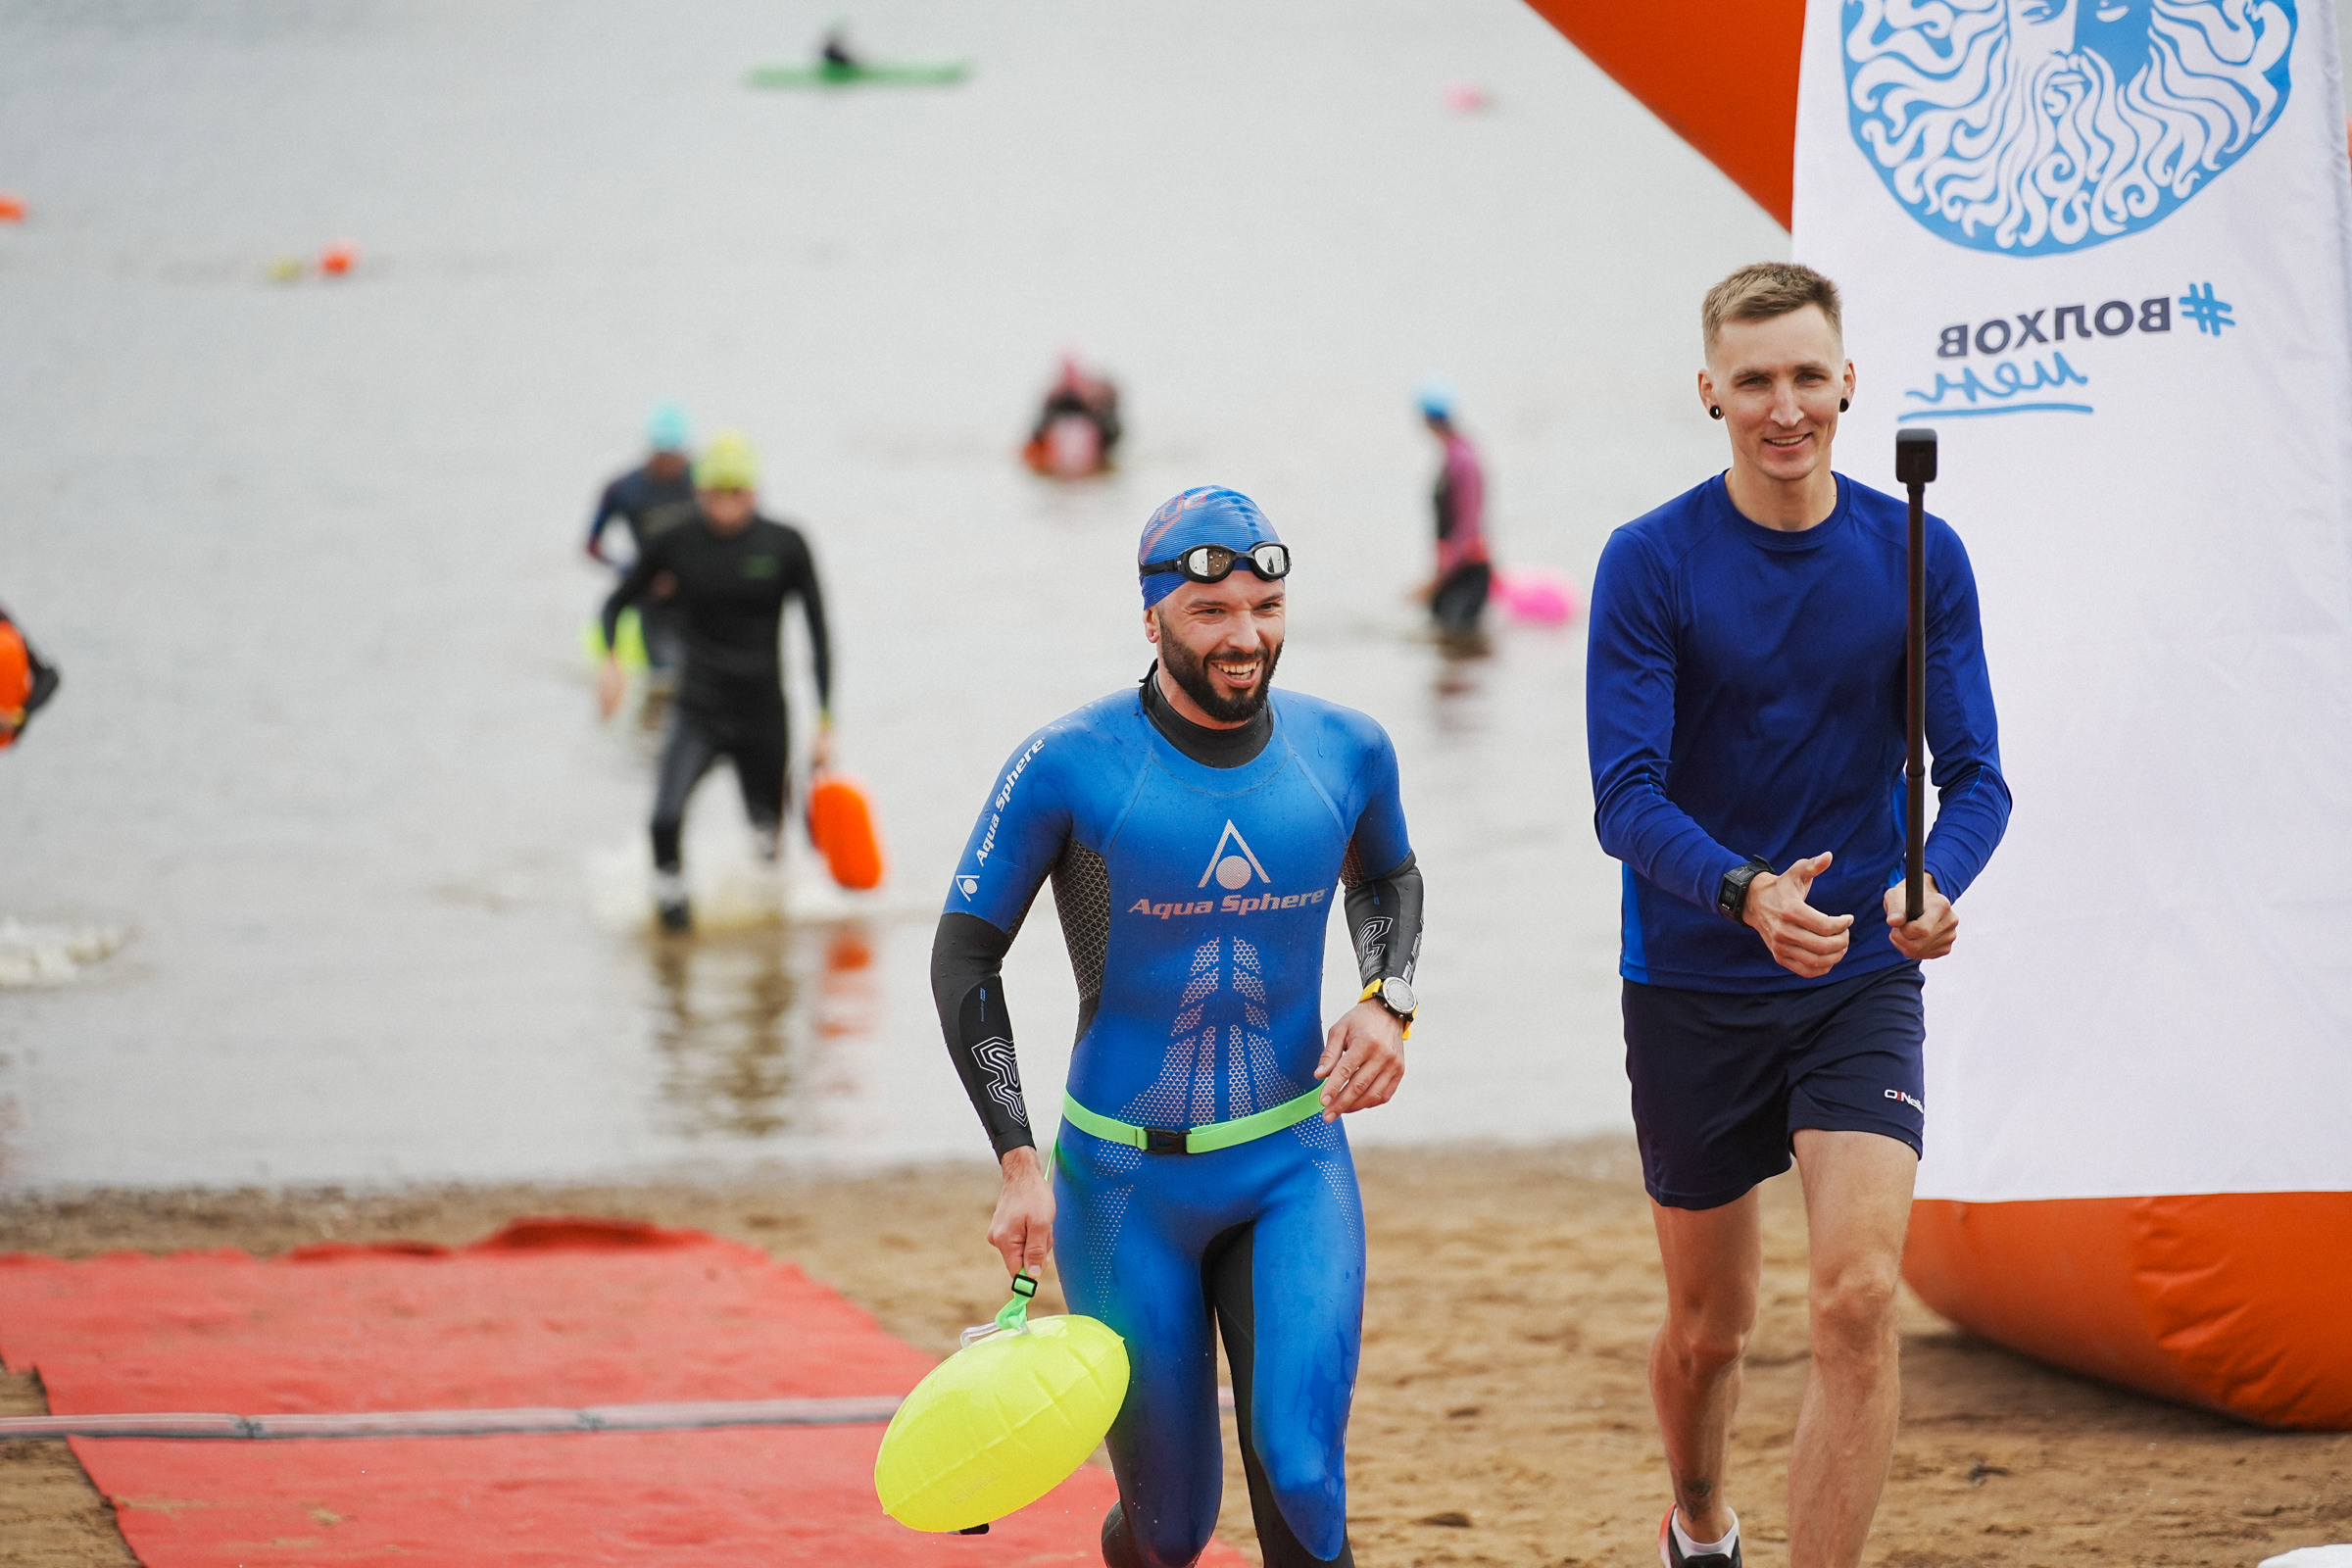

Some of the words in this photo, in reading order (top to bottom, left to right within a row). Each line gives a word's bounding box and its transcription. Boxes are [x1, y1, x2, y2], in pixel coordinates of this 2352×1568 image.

[976, 813, 1000, 867] Aqua
[996, 738, 1045, 812] Sphere
[1128, 899, 1213, 919] Aqua
[1220, 889, 1326, 915] Sphere
